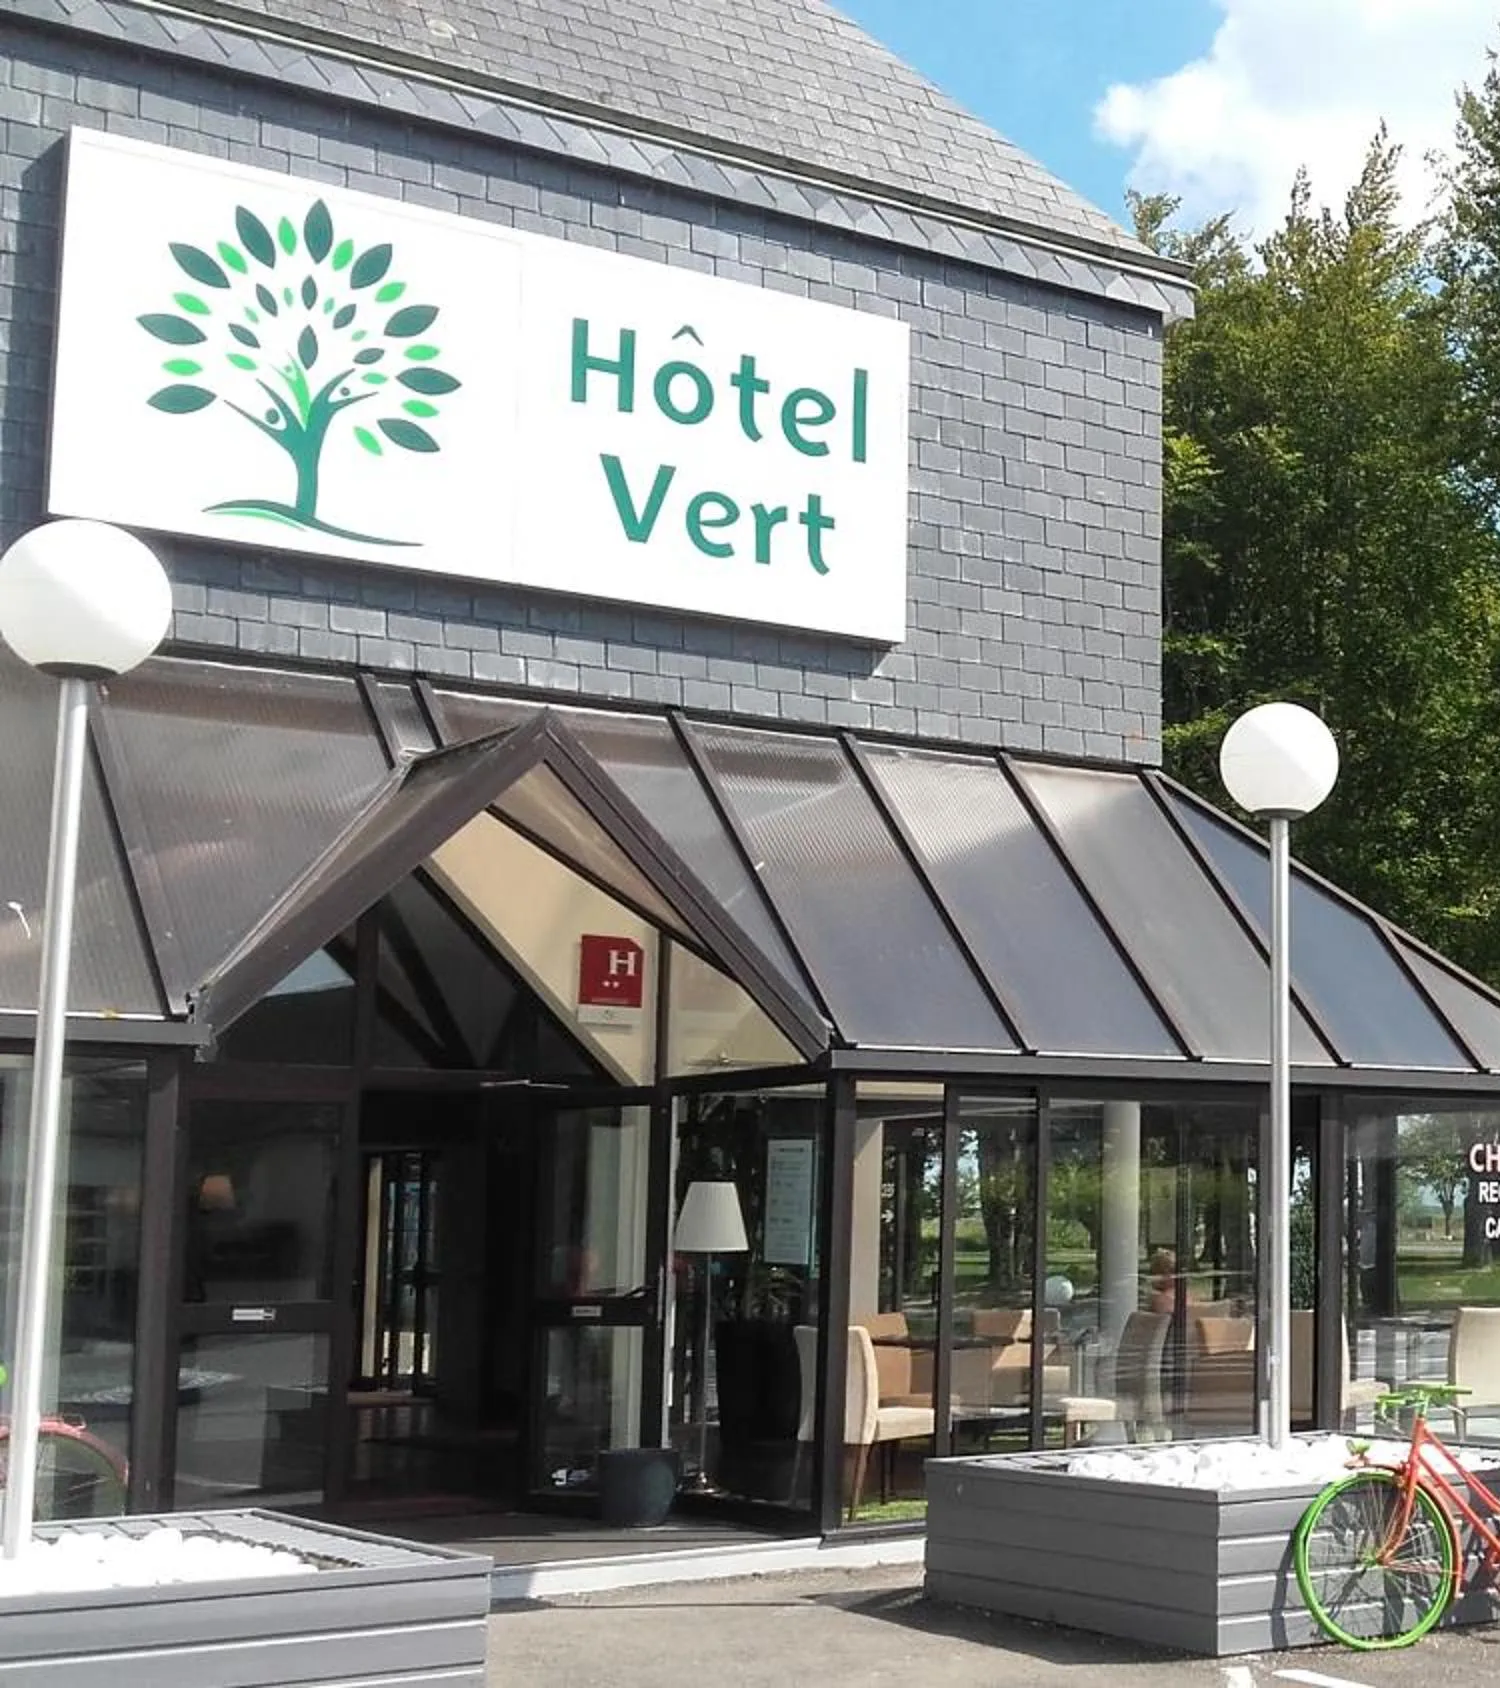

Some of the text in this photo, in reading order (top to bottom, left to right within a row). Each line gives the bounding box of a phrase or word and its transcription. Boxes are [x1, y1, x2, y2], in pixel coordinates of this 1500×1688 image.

[570, 318, 868, 464] Hôtel
[600, 453, 836, 575] Vert
[608, 949, 637, 977] H
